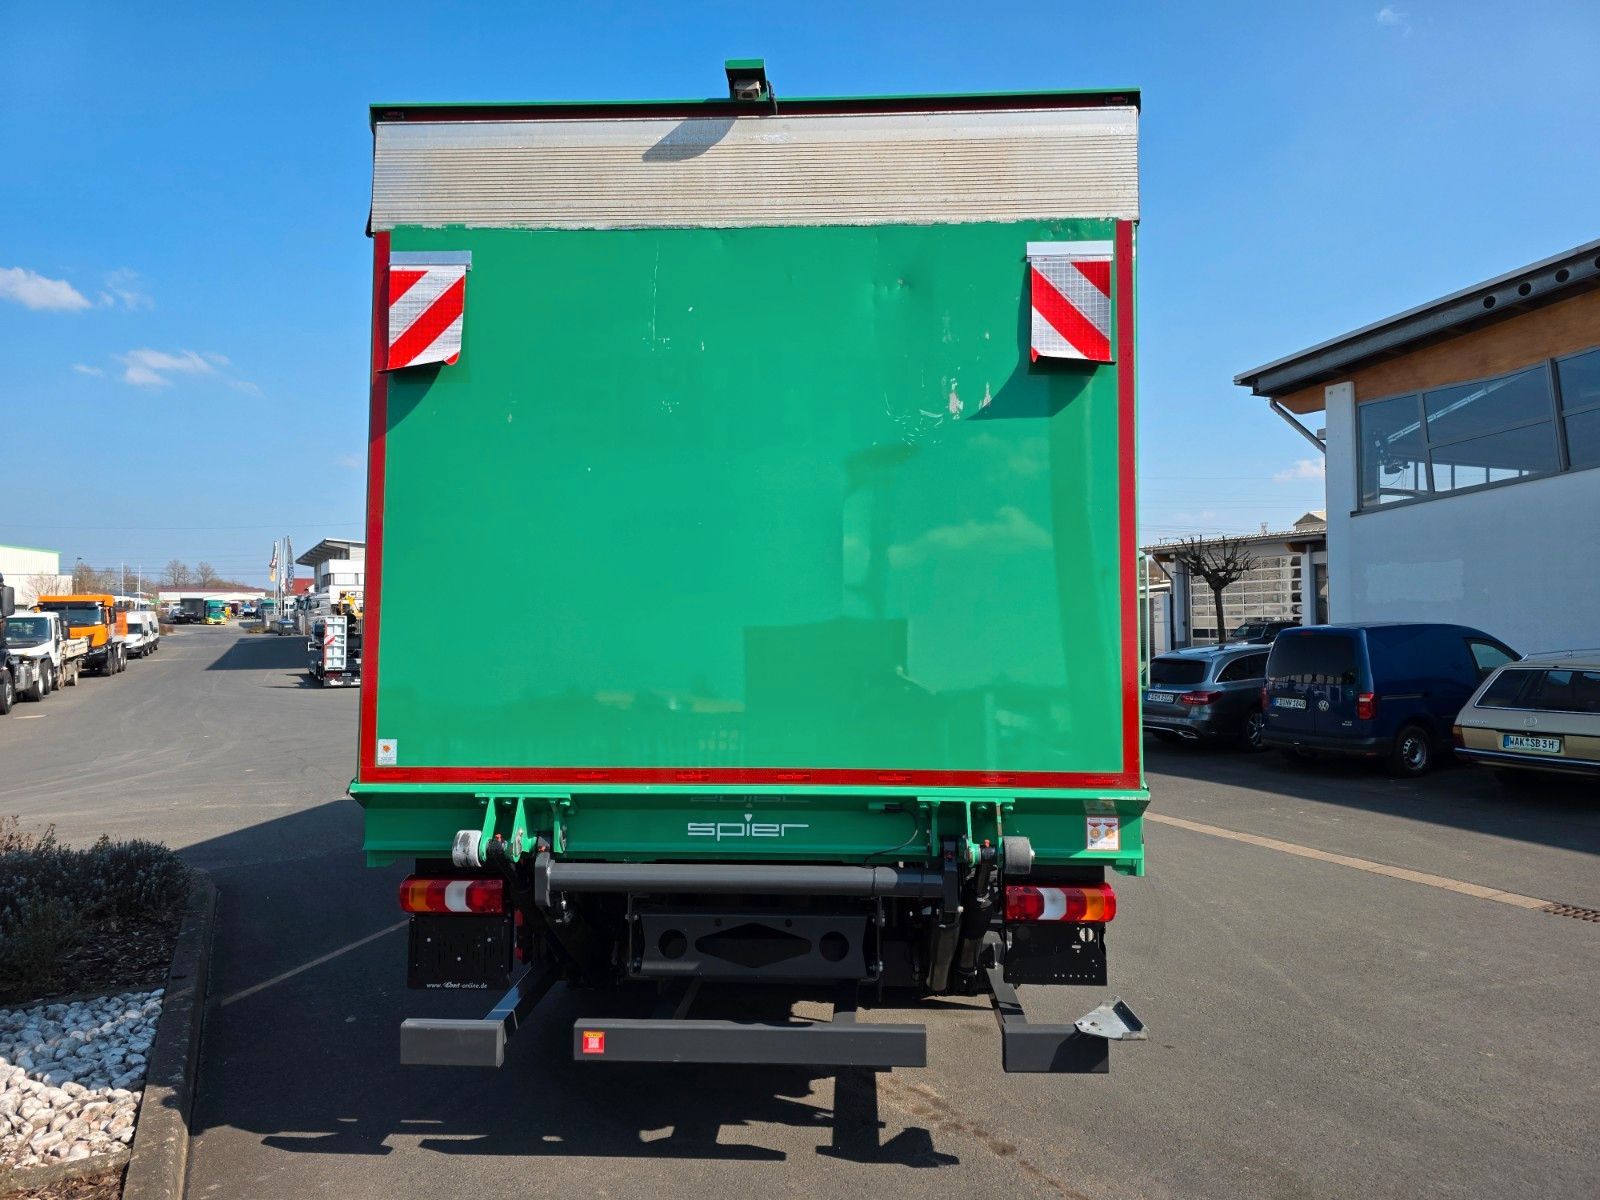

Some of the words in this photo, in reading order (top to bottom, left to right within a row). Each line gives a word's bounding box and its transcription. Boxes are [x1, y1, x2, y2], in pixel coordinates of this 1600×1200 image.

[1510, 737, 1524, 746] WAK
[1530, 739, 1541, 747] SB
[687, 813, 810, 842] spier
